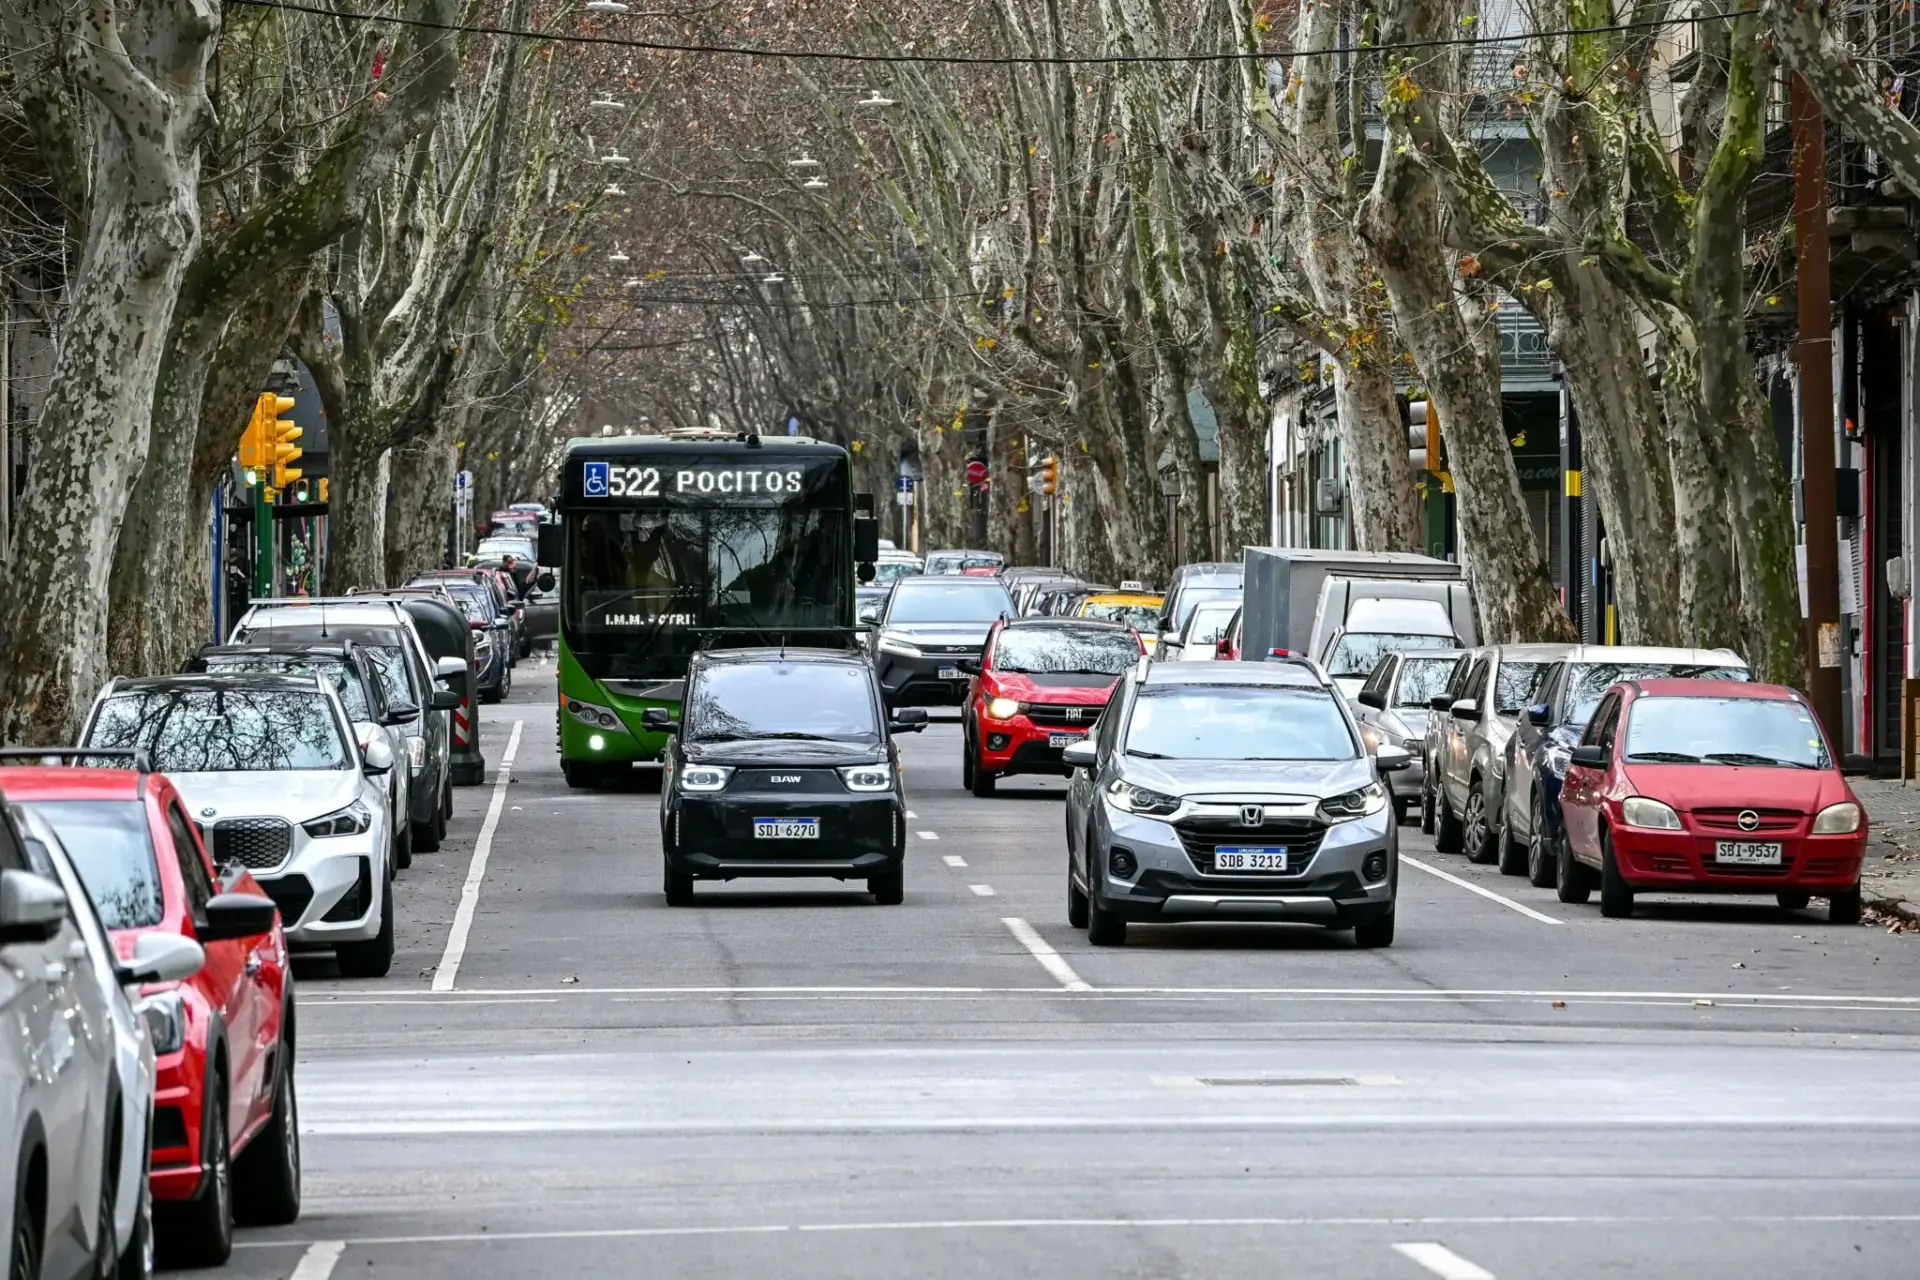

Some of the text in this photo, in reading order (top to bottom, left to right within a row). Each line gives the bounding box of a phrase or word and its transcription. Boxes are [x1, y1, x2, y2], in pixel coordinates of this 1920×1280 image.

[609, 467, 801, 496] 522 POCITOS
[605, 614, 644, 625] I.M.M.
[1065, 708, 1083, 720] FIAT
[1052, 737, 1069, 746] SCT
[758, 825, 816, 837] SDI 6270
[1719, 843, 1779, 858] SBI 9537
[1220, 854, 1283, 868] SDB 3212
